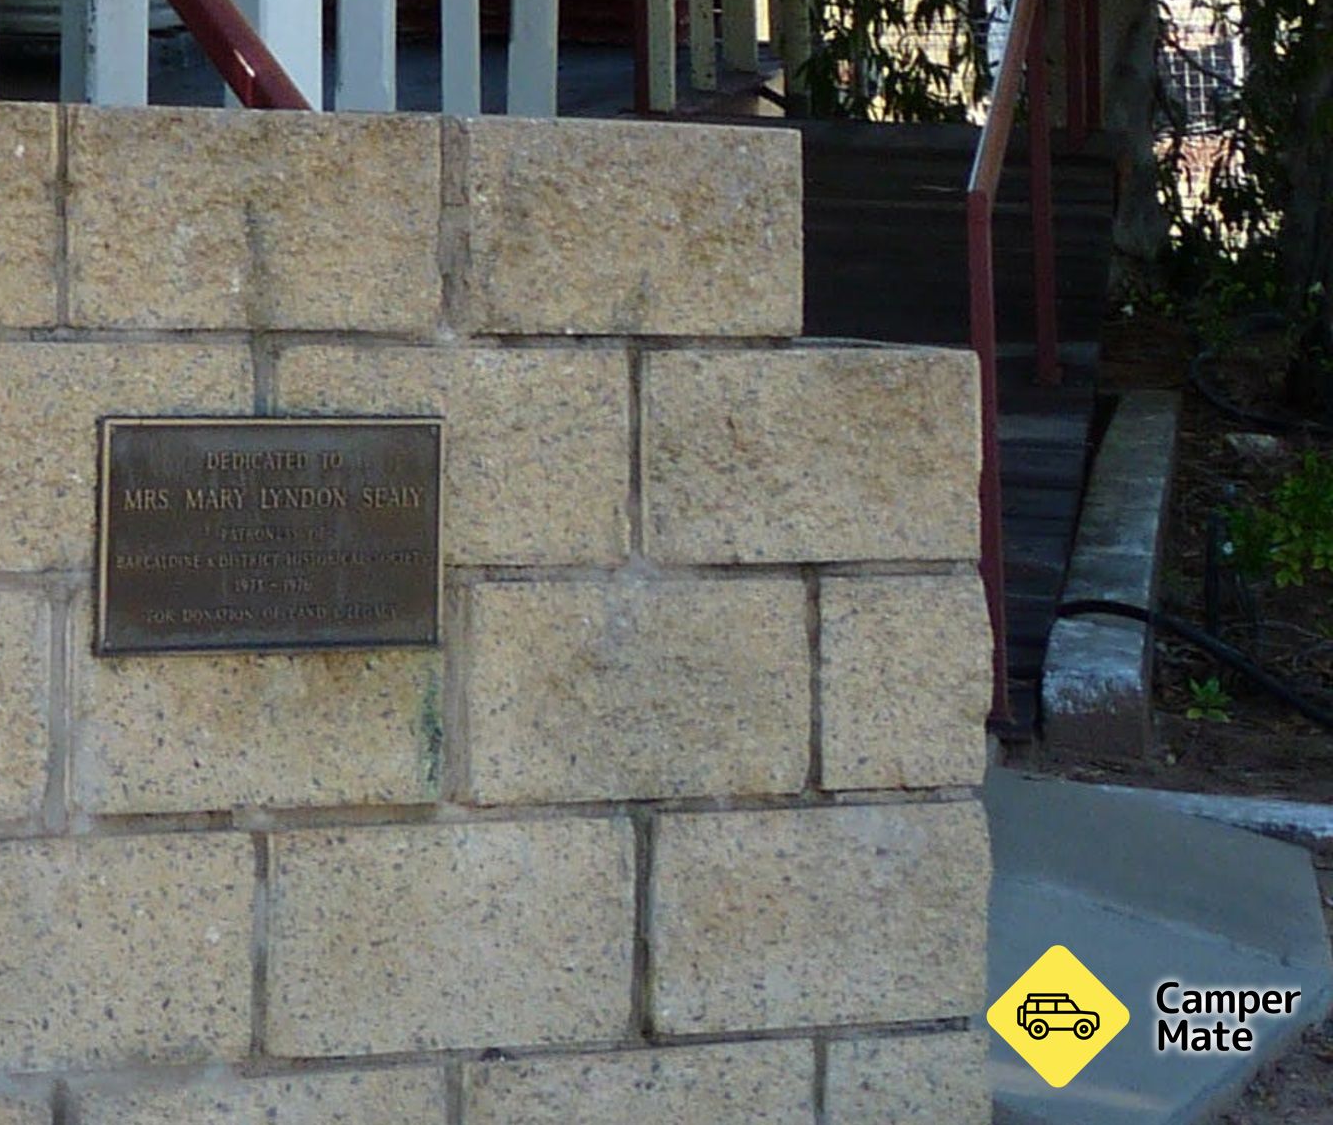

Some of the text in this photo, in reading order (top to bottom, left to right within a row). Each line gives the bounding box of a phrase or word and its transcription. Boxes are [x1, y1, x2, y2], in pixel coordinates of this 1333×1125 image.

[205, 450, 343, 472] DEDICATED TO
[123, 485, 425, 512] MRS MARY LYNDON SEALY
